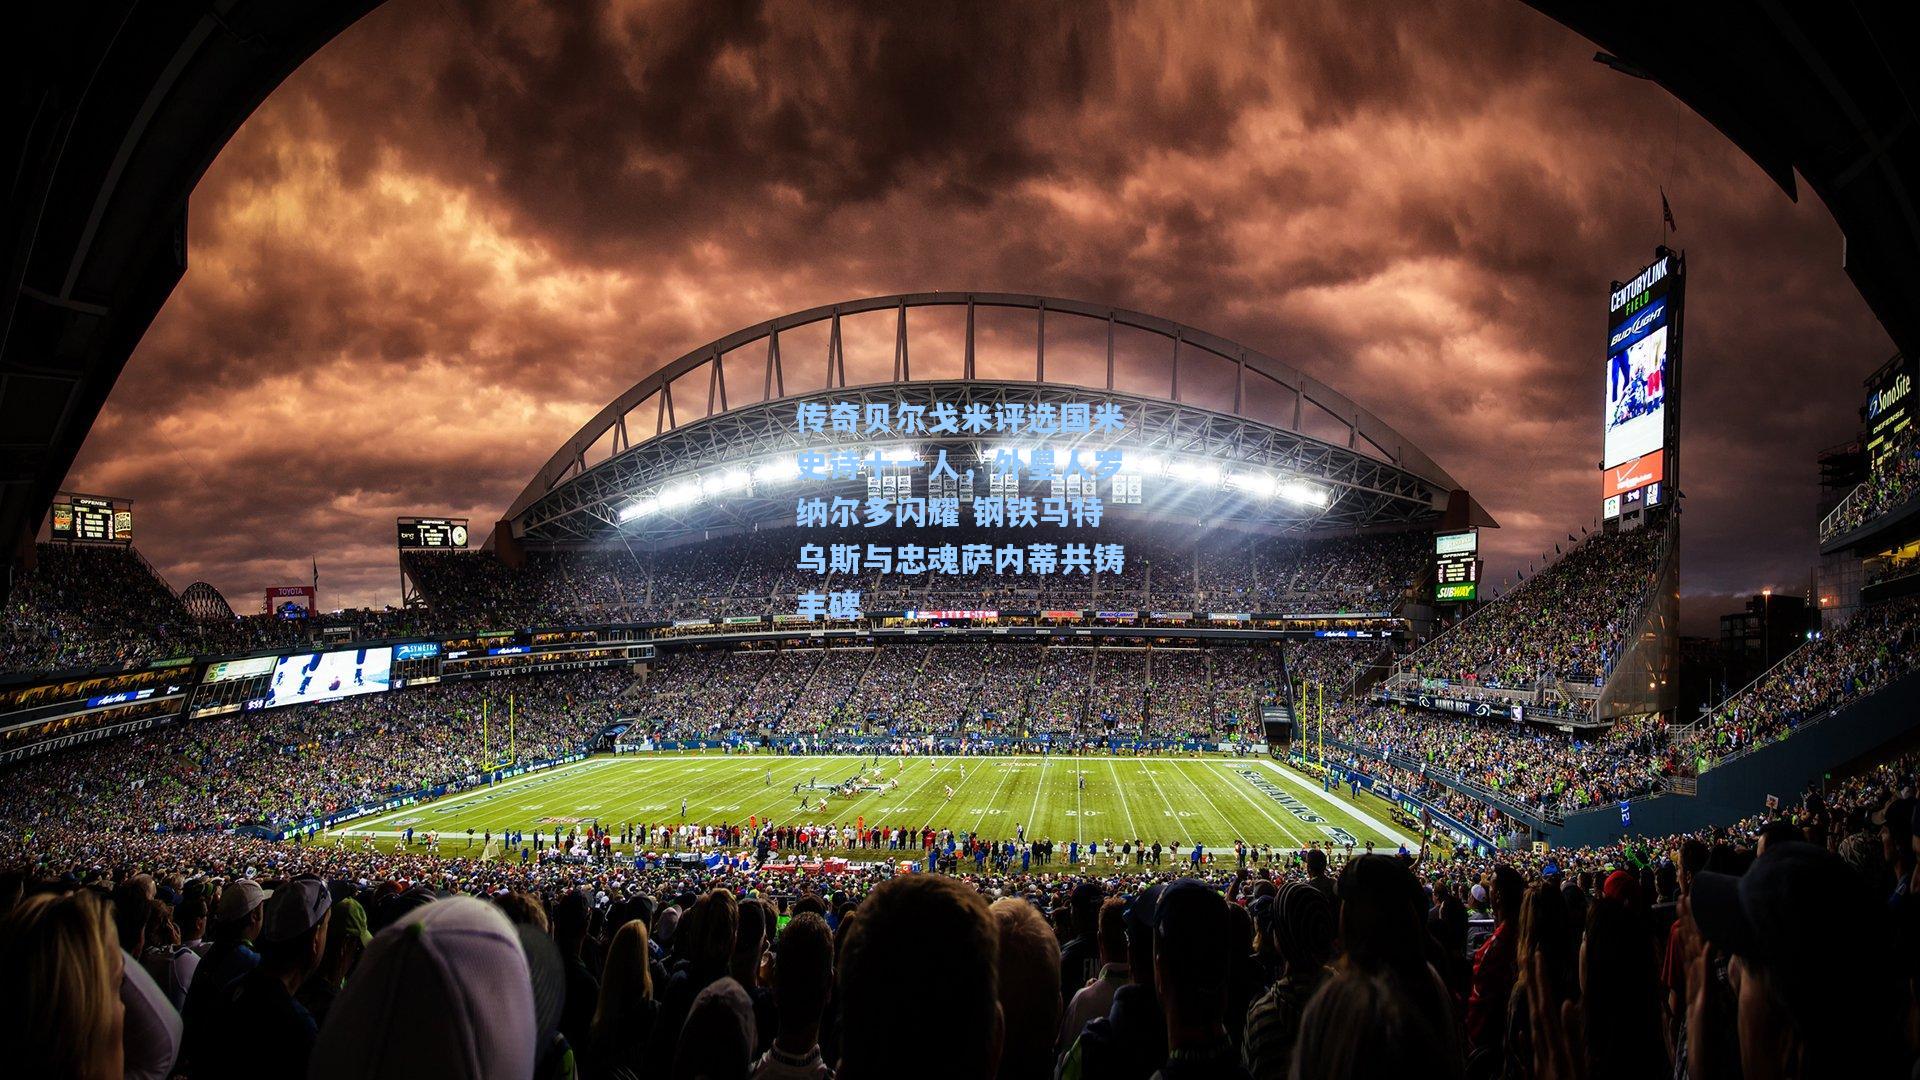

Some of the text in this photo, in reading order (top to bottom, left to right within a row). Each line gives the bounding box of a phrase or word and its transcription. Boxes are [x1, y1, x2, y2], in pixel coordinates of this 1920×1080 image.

[1611, 256, 1669, 313] CENTURYLINK
[1625, 290, 1649, 317] FIELD
[1610, 305, 1665, 347] BUD LIGHT
[1877, 373, 1912, 414] SonoSite
[401, 532, 415, 540] bing
[278, 587, 303, 596] TOYOTA
[1437, 584, 1474, 599] SUBWAY
[409, 643, 438, 652] SYMETRA
[489, 669, 516, 677] HOME
[538, 664, 555, 672] THE
[1434, 698, 1471, 712] HAWKS NEST
[9, 749, 24, 762] TO
[30, 728, 112, 756] CENTURYLINK
[118, 719, 153, 735] FIELD
[1236, 768, 1328, 824] SEAHAWKS
[1620, 806, 1631, 822] 12
